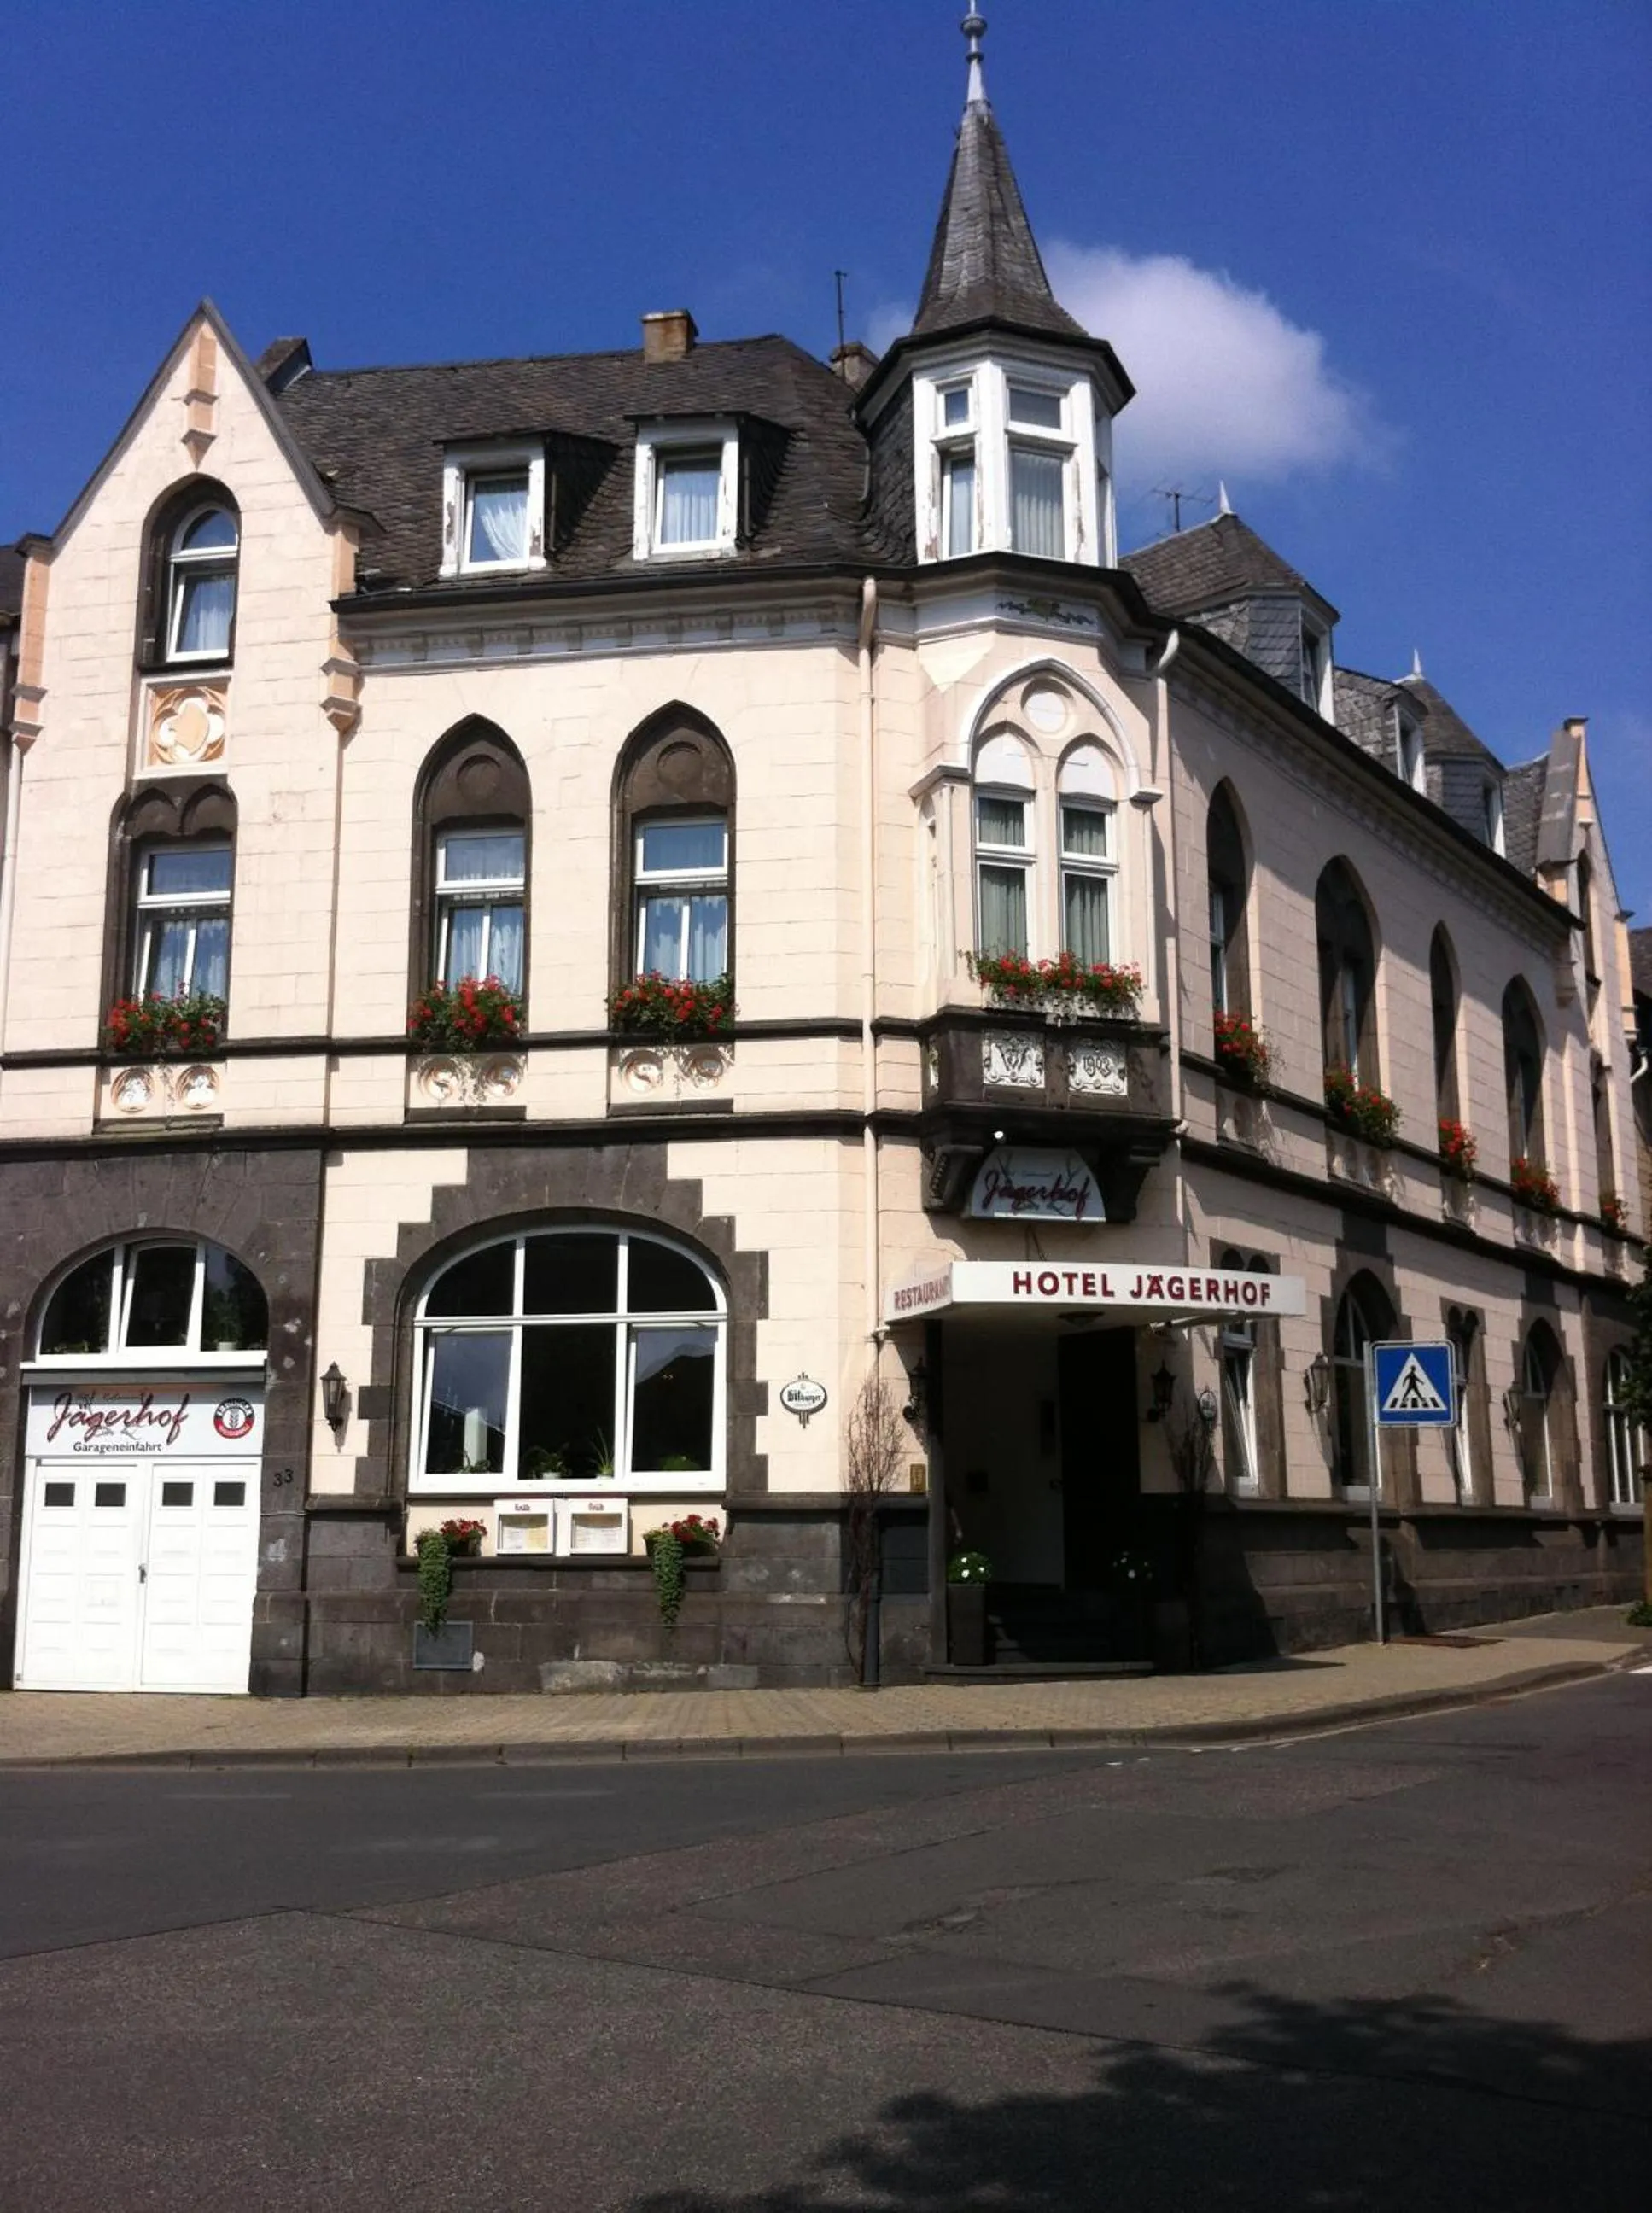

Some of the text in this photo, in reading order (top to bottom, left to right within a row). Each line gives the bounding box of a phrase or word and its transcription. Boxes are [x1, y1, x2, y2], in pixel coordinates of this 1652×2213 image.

[1013, 1271, 1271, 1306] HOTEL JÄGERHOF
[73, 1441, 162, 1455] Garageneinfahrt
[273, 1469, 294, 1487] 33
